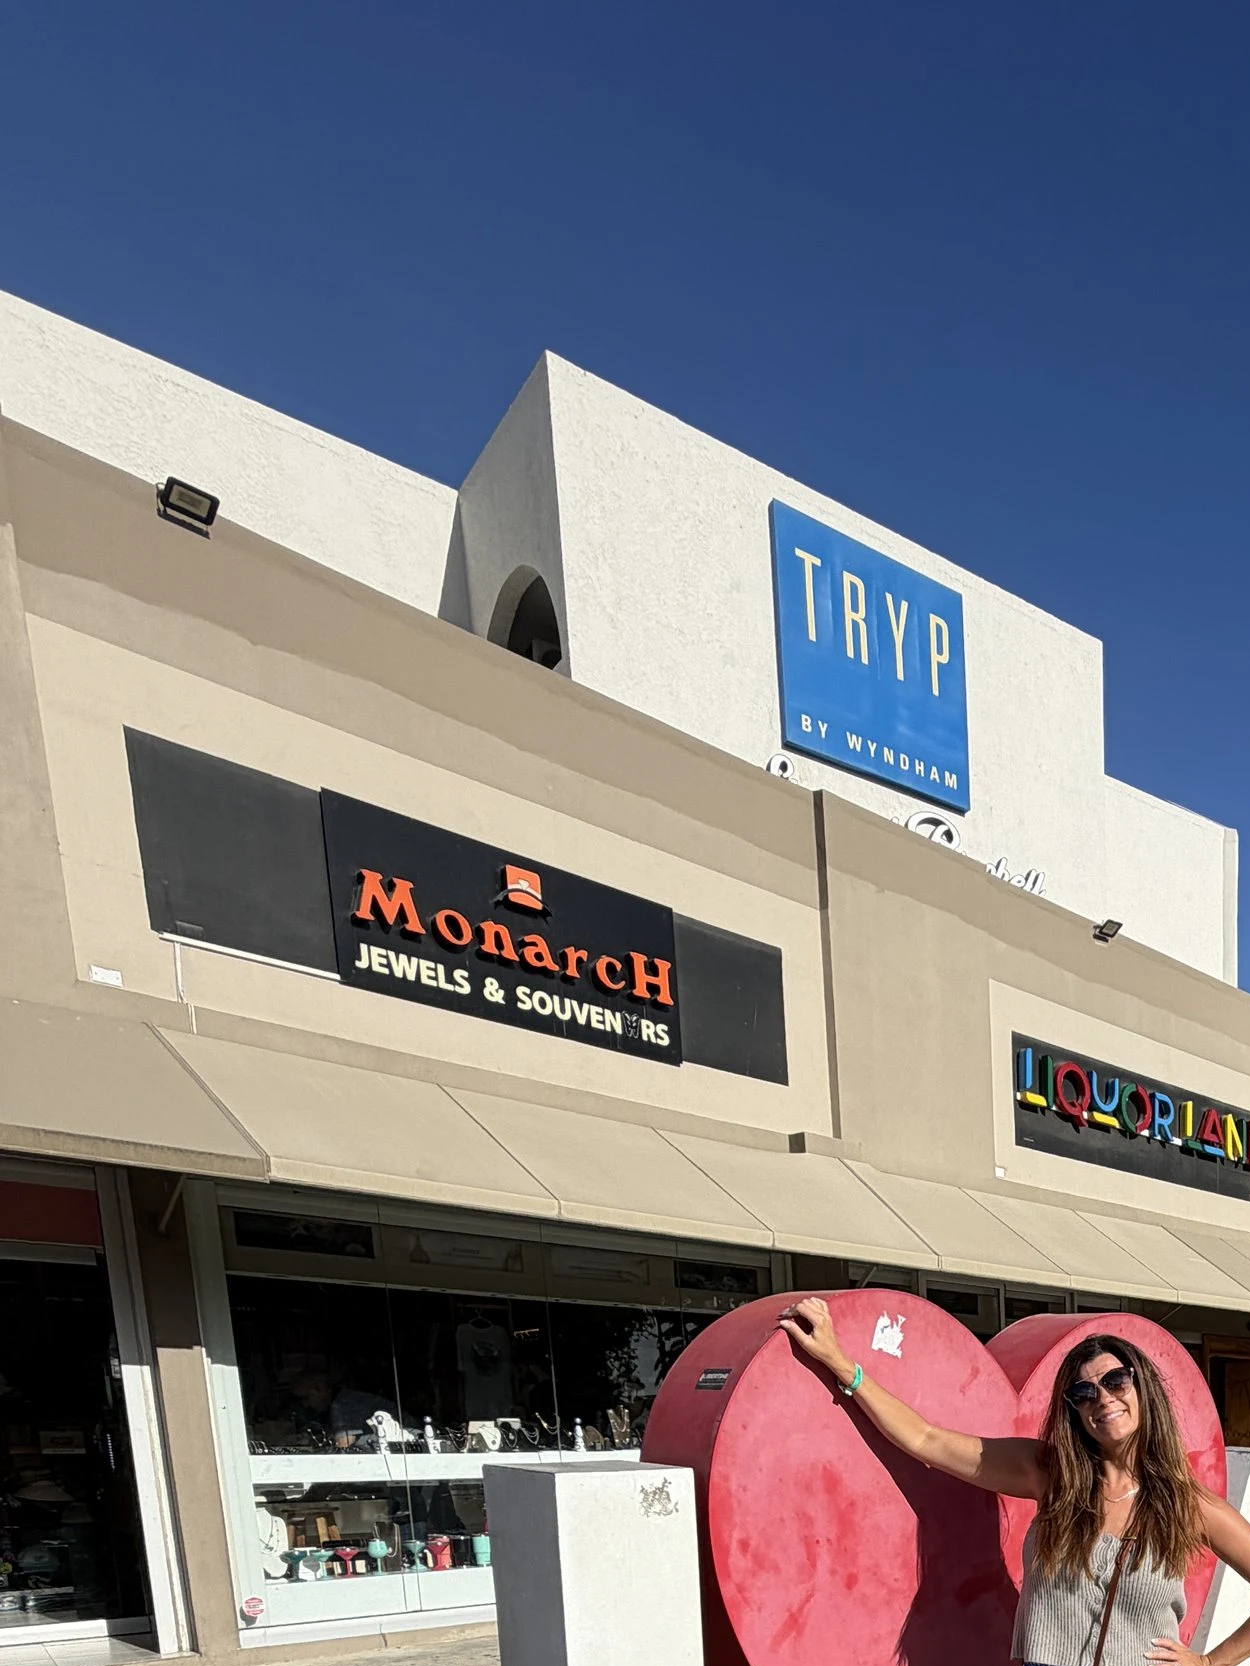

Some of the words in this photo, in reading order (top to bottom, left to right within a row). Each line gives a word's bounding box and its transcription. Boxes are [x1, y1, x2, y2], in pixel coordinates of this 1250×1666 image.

[795, 547, 950, 697] TRYP
[801, 713, 828, 739] BY
[846, 731, 958, 790] WYNDHAM
[354, 942, 472, 995] JEWELS
[482, 976, 506, 1005] &
[516, 985, 670, 1047] SOUVENRS
